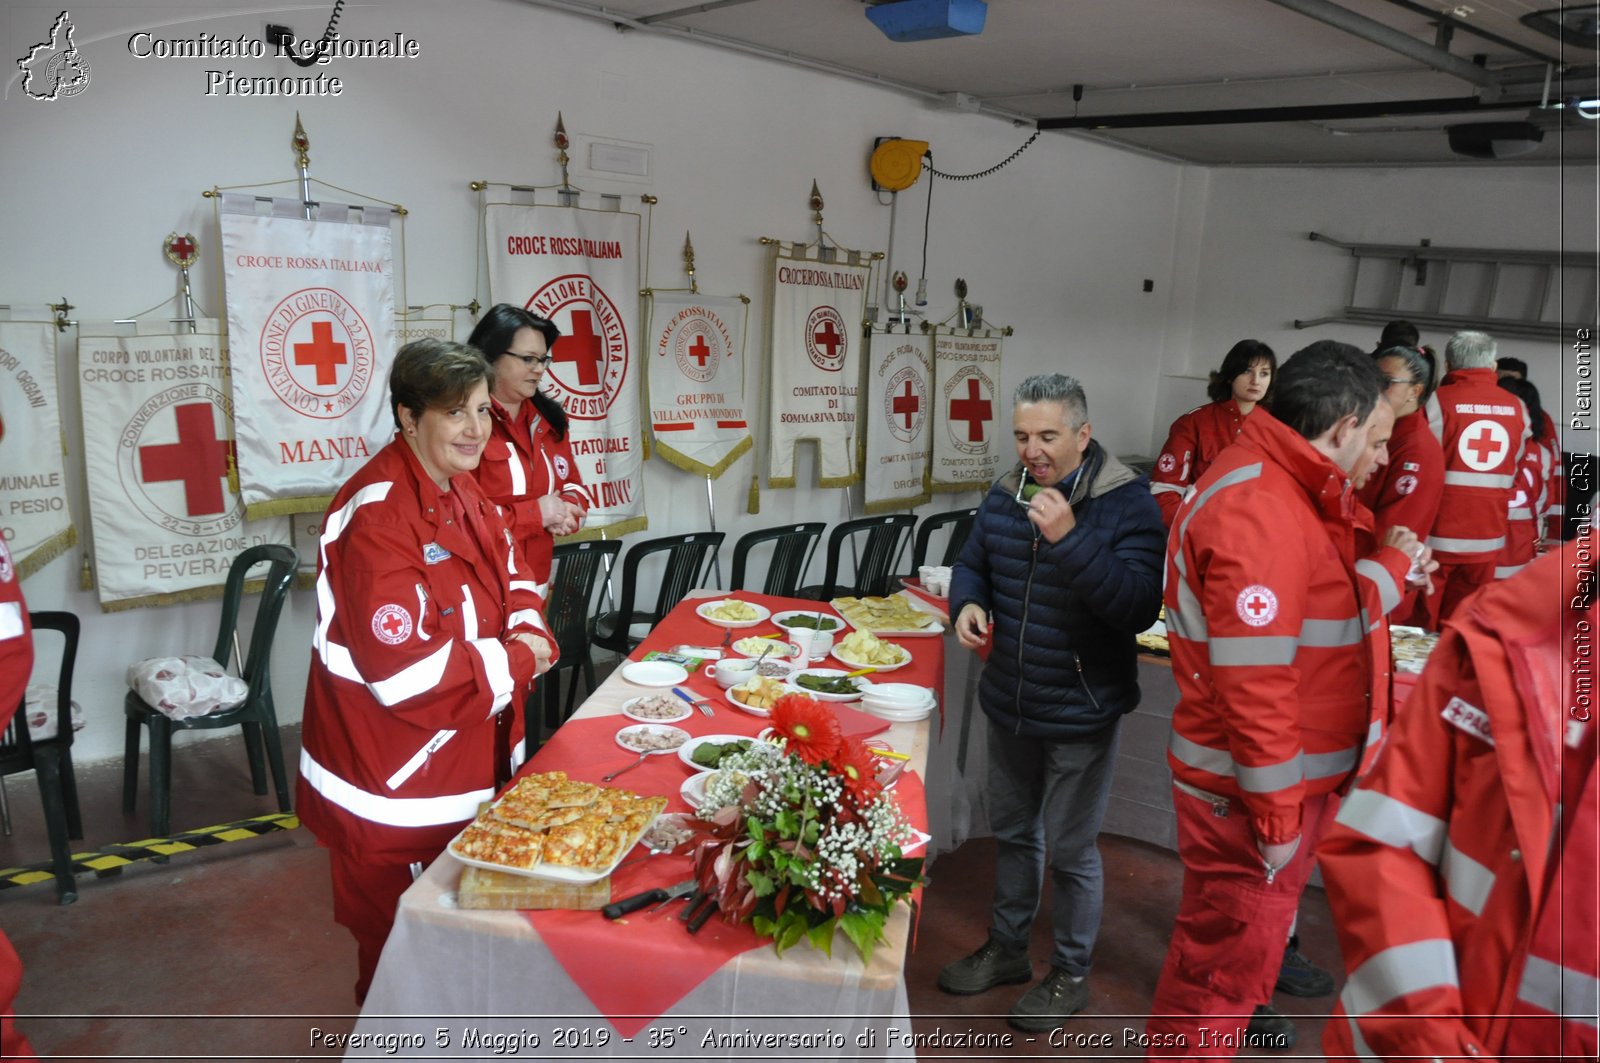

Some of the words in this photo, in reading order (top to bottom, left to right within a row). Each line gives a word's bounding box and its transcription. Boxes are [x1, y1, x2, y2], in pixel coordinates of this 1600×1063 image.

[507, 236, 548, 255] CROCE
[549, 237, 584, 256] ROSSA
[236, 255, 282, 269] CROCE
[286, 257, 328, 270] ROSSA
[330, 259, 382, 273] ITALIANA
[279, 304, 298, 325] DI
[296, 292, 349, 321] GINEVRA
[346, 319, 363, 337] 22
[398, 328, 447, 339] SOCCORSO
[596, 298, 623, 362] GINEVRA
[658, 317, 679, 357] CROCE
[678, 306, 706, 321] ROSSA
[707, 311, 734, 358] ITALIANA
[92, 350, 129, 364] CORPO
[135, 347, 193, 365] VOLONTARI
[199, 347, 215, 361] DEL
[351, 338, 370, 392] AGOSTO
[82, 368, 145, 383] CROCE
[151, 364, 210, 382] ROSSA
[265, 319, 320, 413] CONVENZIONE
[16, 370, 47, 408] ORGANI
[793, 386, 837, 397] COMITATO
[562, 395, 605, 415] AGOSTO
[676, 393, 715, 406] GRUPPO
[828, 399, 838, 409] DI
[122, 386, 199, 449] CONVENZIONE
[653, 409, 709, 422] VILLANOVA
[781, 412, 836, 424] SOMMARIVA
[279, 437, 371, 465] MANTA
[595, 459, 607, 475] di
[10, 496, 64, 515] PESIO
[135, 536, 248, 561] DELEGAZIONE
